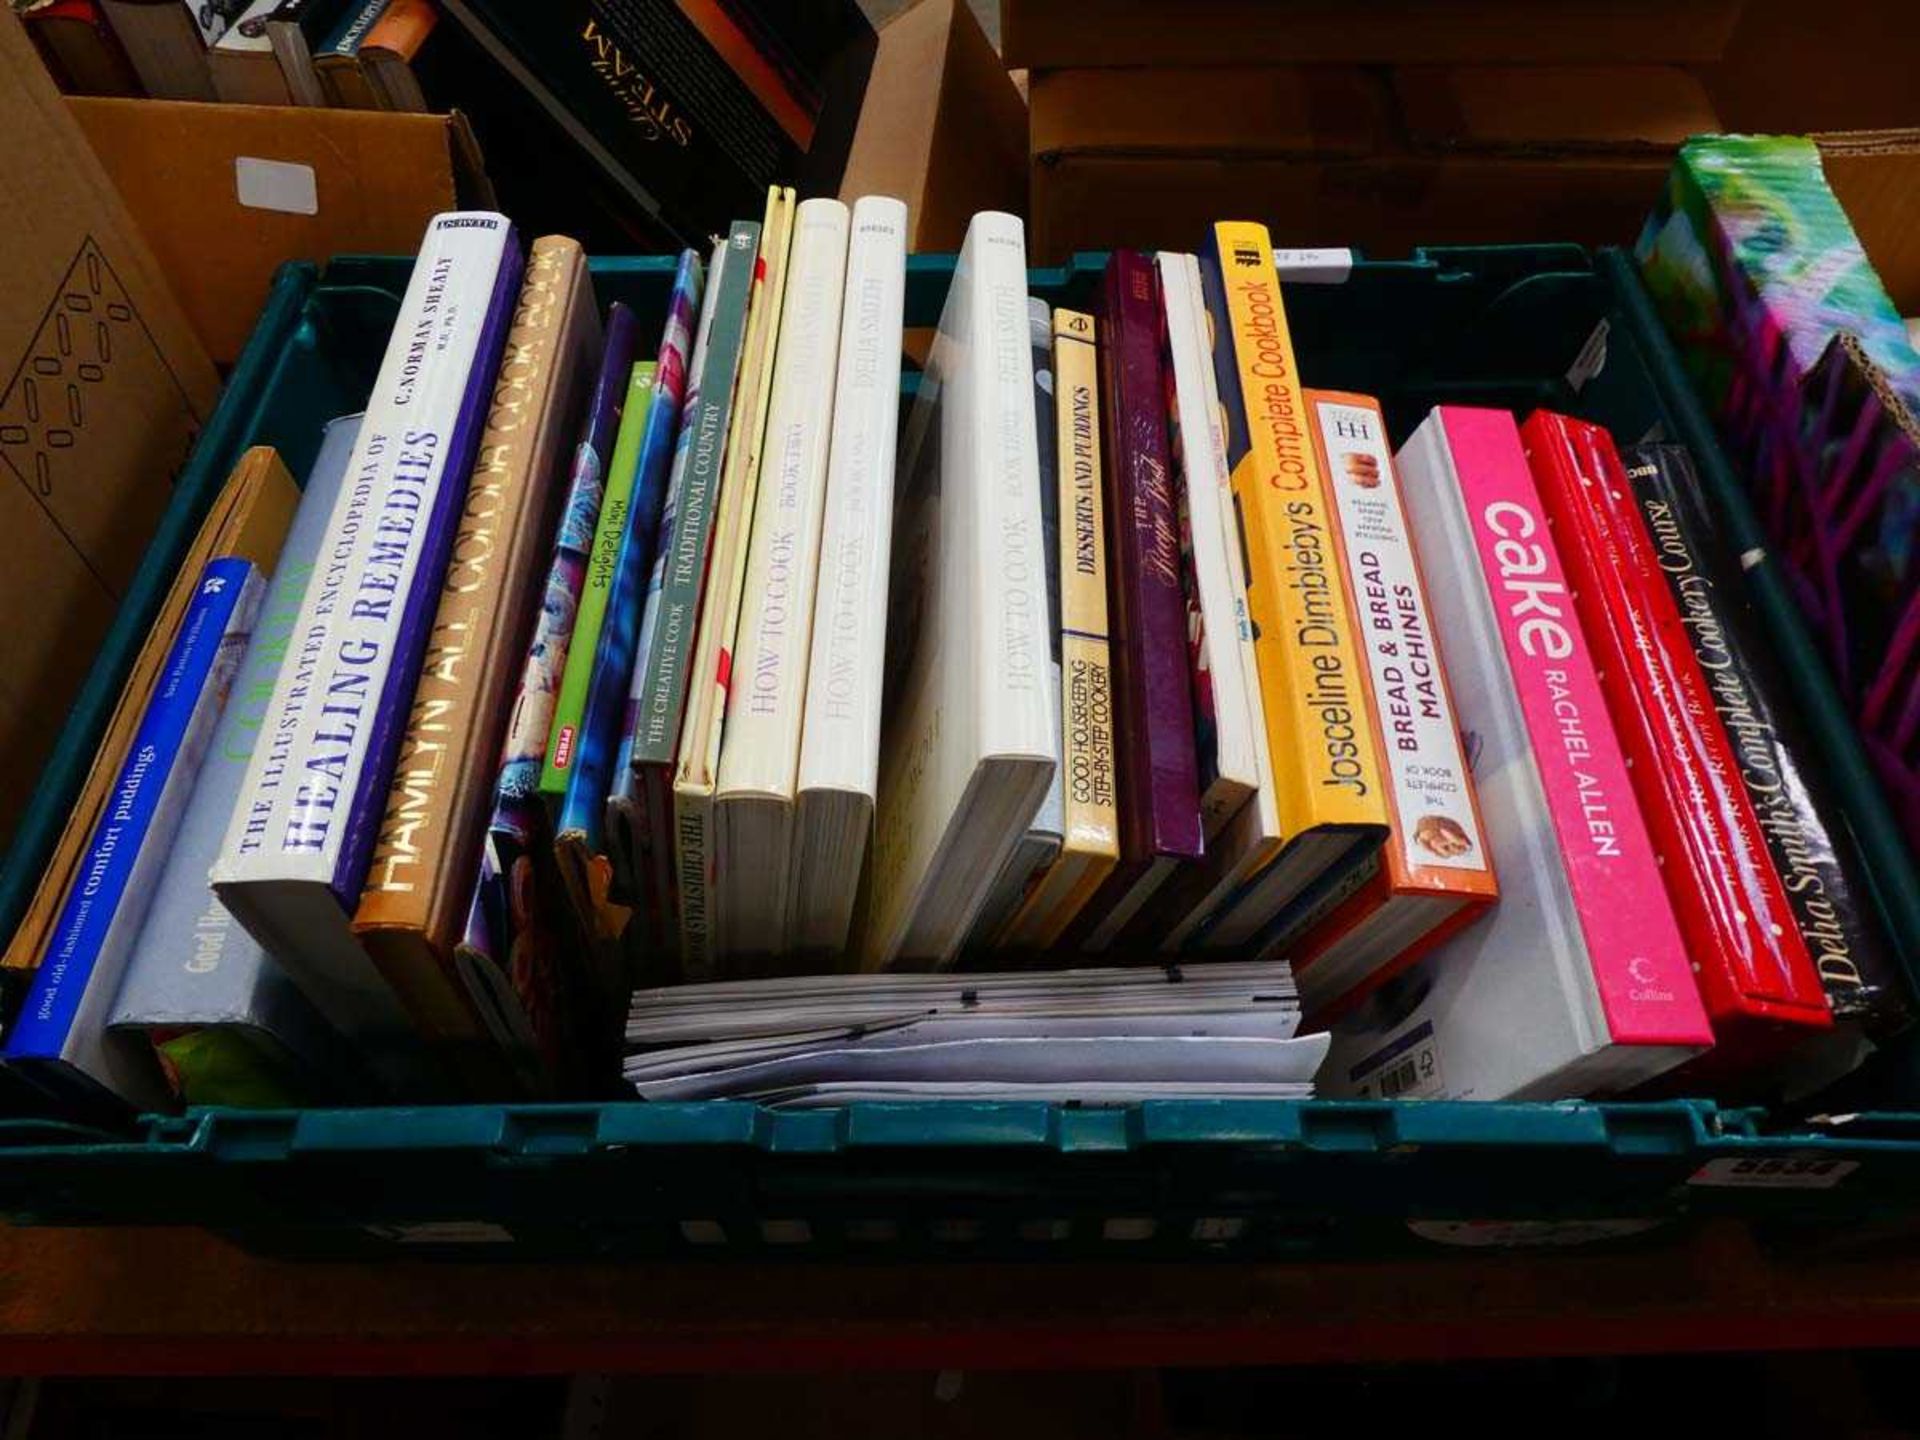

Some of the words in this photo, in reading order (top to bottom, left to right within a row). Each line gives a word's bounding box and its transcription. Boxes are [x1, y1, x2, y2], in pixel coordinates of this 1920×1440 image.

[582, 18, 692, 146] STEAM
[423, 256, 453, 315] SHEALY
[1238, 281, 1287, 380] Cookbook
[1072, 386, 1094, 456] PUDDINGS
[1261, 384, 1310, 492] Complete
[674, 479, 708, 586] TRADITIONAL
[694, 401, 722, 476] COUNTRY
[1074, 460, 1094, 493] AND
[1629, 464, 1659, 480] BBC
[607, 500, 627, 525] Mini
[1074, 494, 1096, 575] DESSERTS
[1134, 495, 1153, 530] THE
[1645, 499, 1693, 572] Course
[591, 530, 623, 589] Delights
[767, 531, 795, 603] COOK
[838, 536, 863, 604] COOK
[1002, 516, 1029, 584] COOK
[1283, 501, 1341, 647] Dimbleby's
[1484, 501, 1574, 660] cake
[667, 603, 684, 642] COOK
[760, 604, 786, 639] TO
[1005, 588, 1031, 621] TO
[1360, 551, 1393, 631] BREAD
[1681, 576, 1732, 670] Cookery
[240, 800, 273, 853] THE
[261, 624, 327, 788] ILLUSTRATED
[316, 461, 379, 616] ENCYCLOPEDIA
[367, 433, 388, 457] OF
[282, 638, 380, 852] HEALING
[350, 430, 439, 622] REMEDIES
[832, 611, 857, 645] TO
[1379, 642, 1398, 658] &
[1394, 585, 1442, 719] MACHINES
[653, 642, 678, 715] CREATIVE
[752, 649, 780, 715] HOW
[826, 657, 853, 720] HOW
[1072, 659, 1089, 752] HOUSEKEEPING
[1089, 663, 1110, 723] COOKERY
[1387, 665, 1418, 751] BREAD
[368, 698, 452, 892] HAMLYN
[422, 608, 479, 685] ALL
[648, 716, 666, 744] THE
[1306, 654, 1368, 797] Josceline
[1714, 671, 1783, 793] Complete
[1073, 756, 1090, 804] GOOD
[1091, 725, 1112, 808] STEP-BY-STEP
[1544, 669, 1592, 765] RACHEL
[1573, 771, 1622, 859] ALLEN
[83, 826, 123, 896] comfort
[113, 743, 156, 821] puddings
[679, 814, 705, 848] THE
[1760, 793, 1827, 893] Smith's
[1803, 900, 1865, 986] Delia
